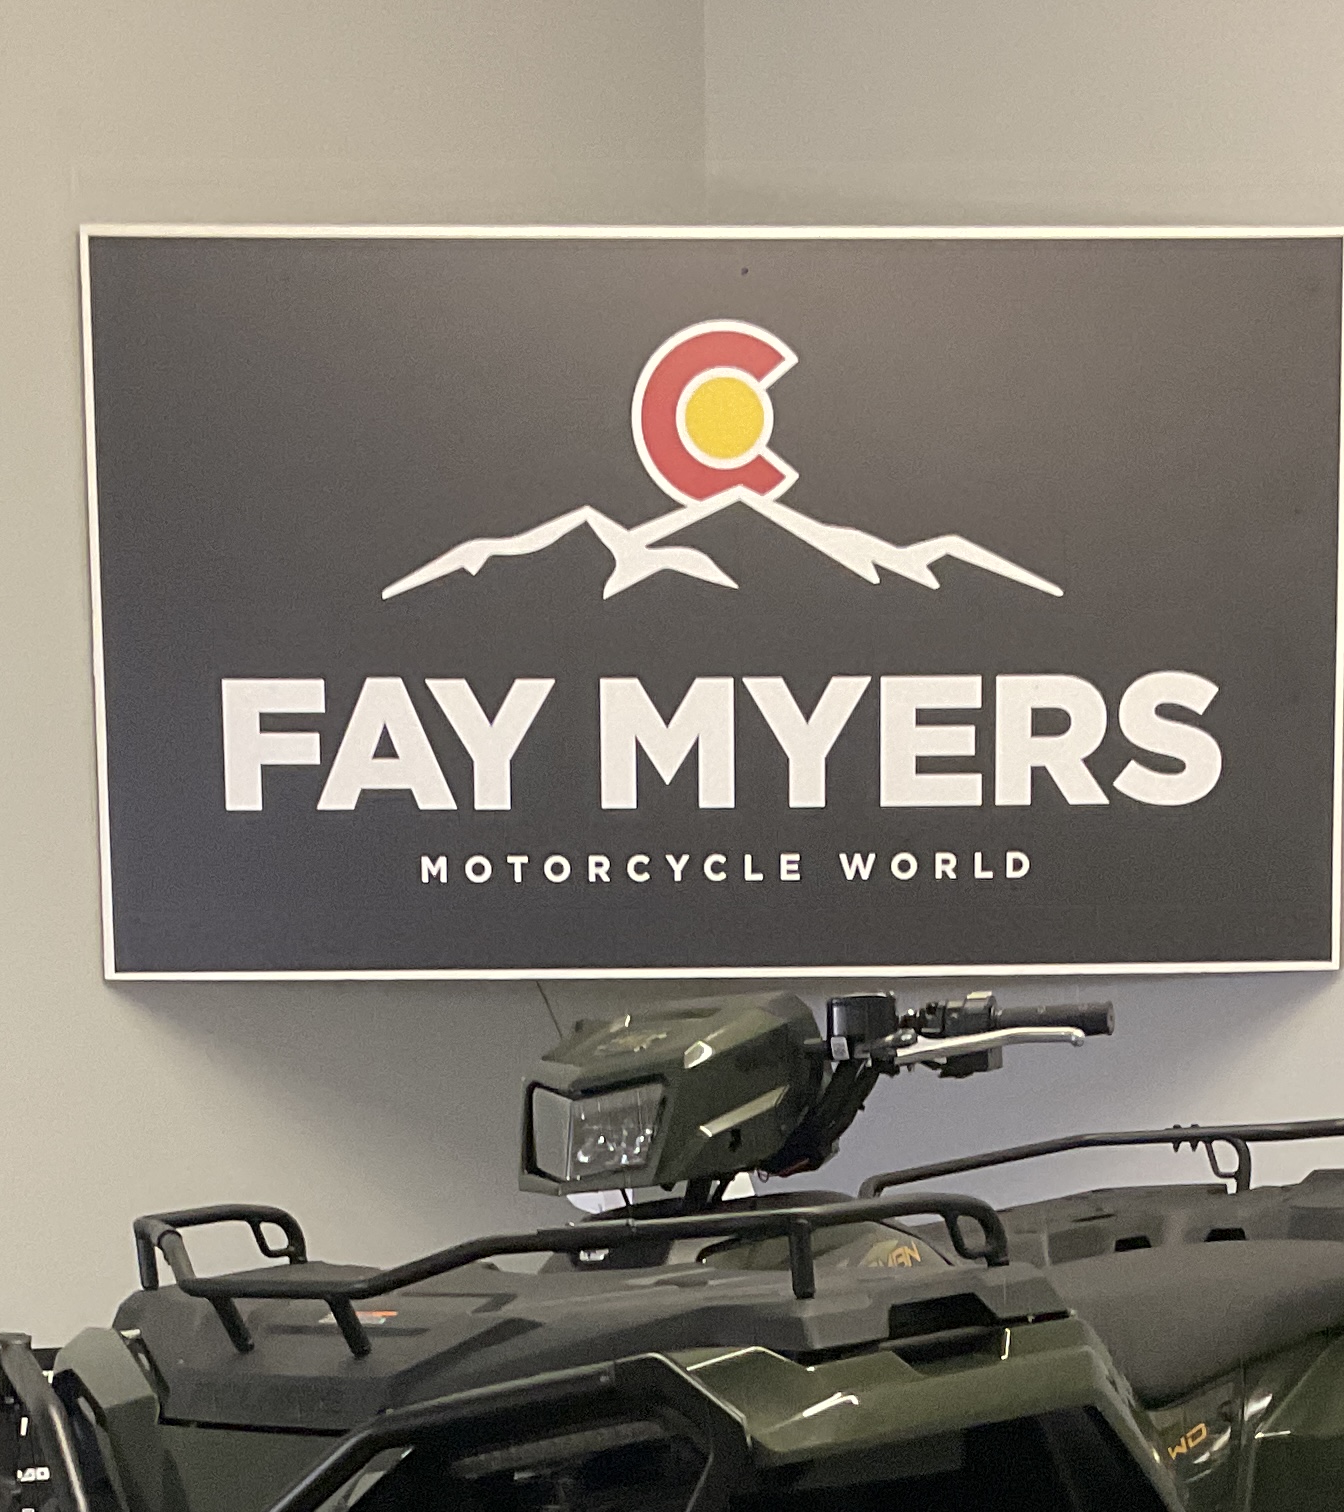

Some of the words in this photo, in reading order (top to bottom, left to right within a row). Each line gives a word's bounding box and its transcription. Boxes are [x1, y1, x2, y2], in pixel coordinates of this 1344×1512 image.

[222, 678, 555, 810] FAY
[600, 672, 1221, 808] MYERS
[422, 854, 800, 882] MOTORCYCLE
[840, 852, 1029, 880] WORLD
